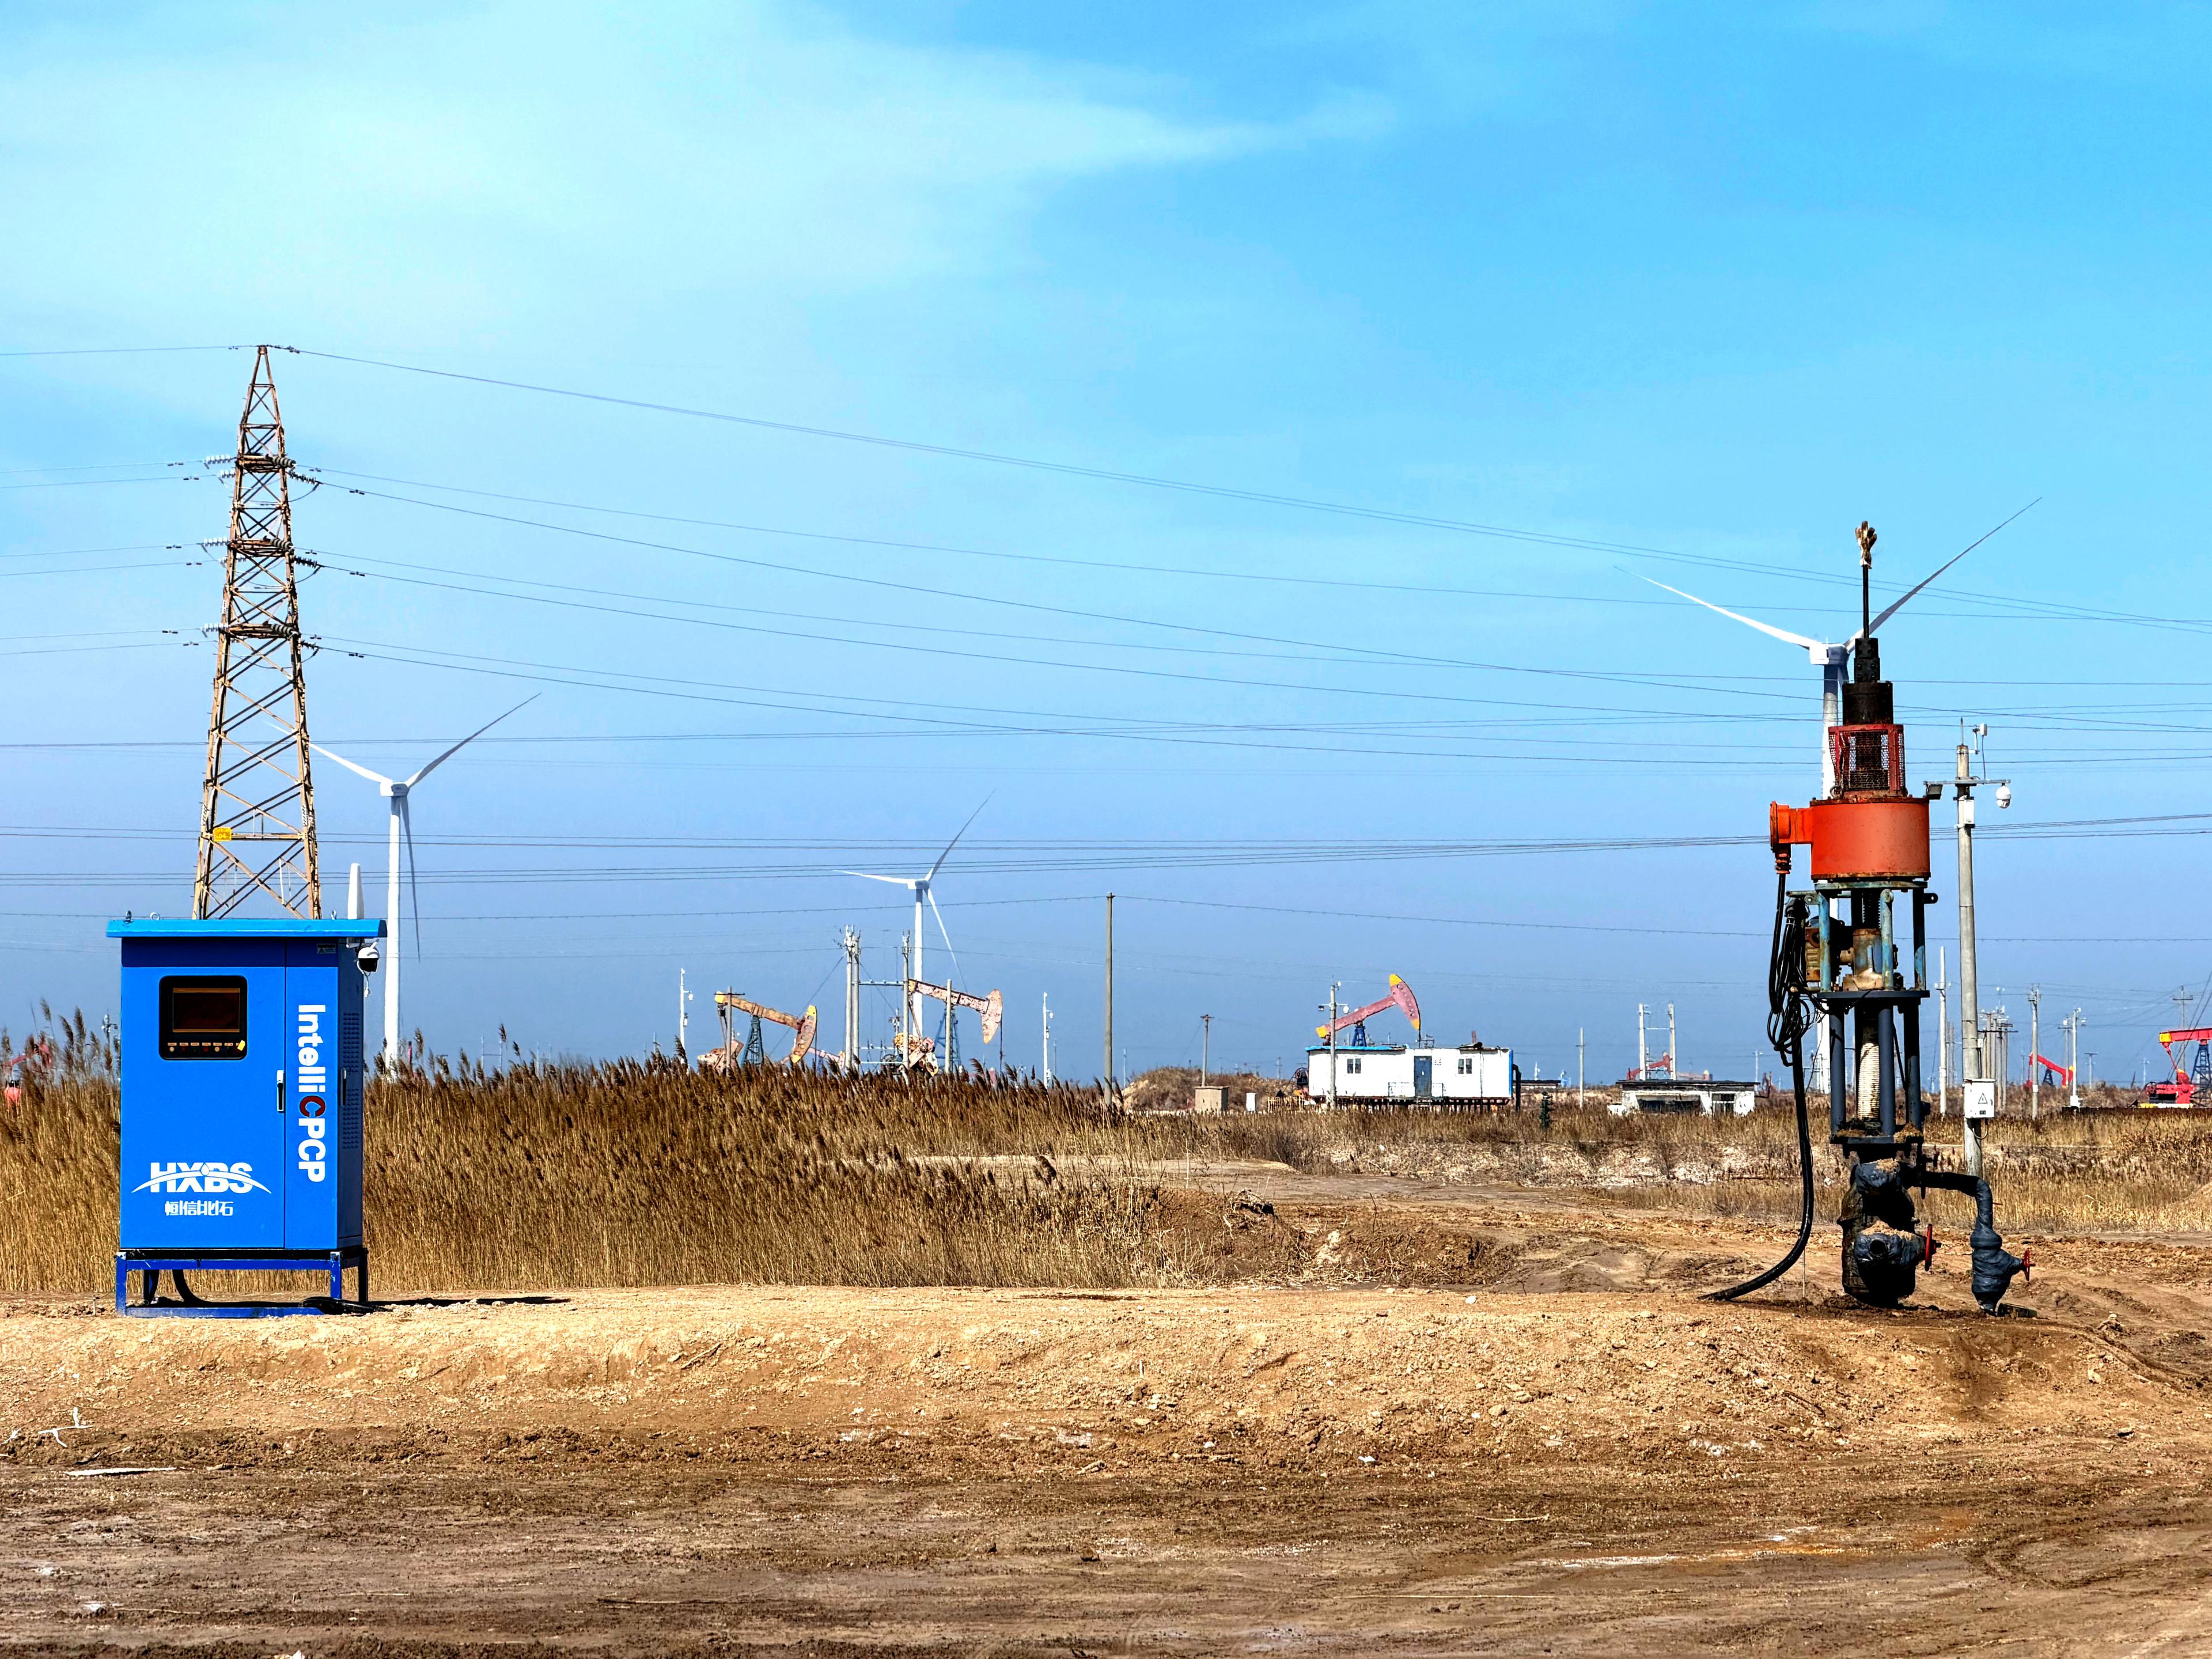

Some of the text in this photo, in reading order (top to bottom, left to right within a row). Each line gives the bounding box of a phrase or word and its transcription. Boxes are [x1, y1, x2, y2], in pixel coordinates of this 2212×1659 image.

[298, 1005, 326, 1182] IntelliCPCP
[150, 1162, 253, 1194] HXBS
[165, 1200, 234, 1216] 恒信北石
